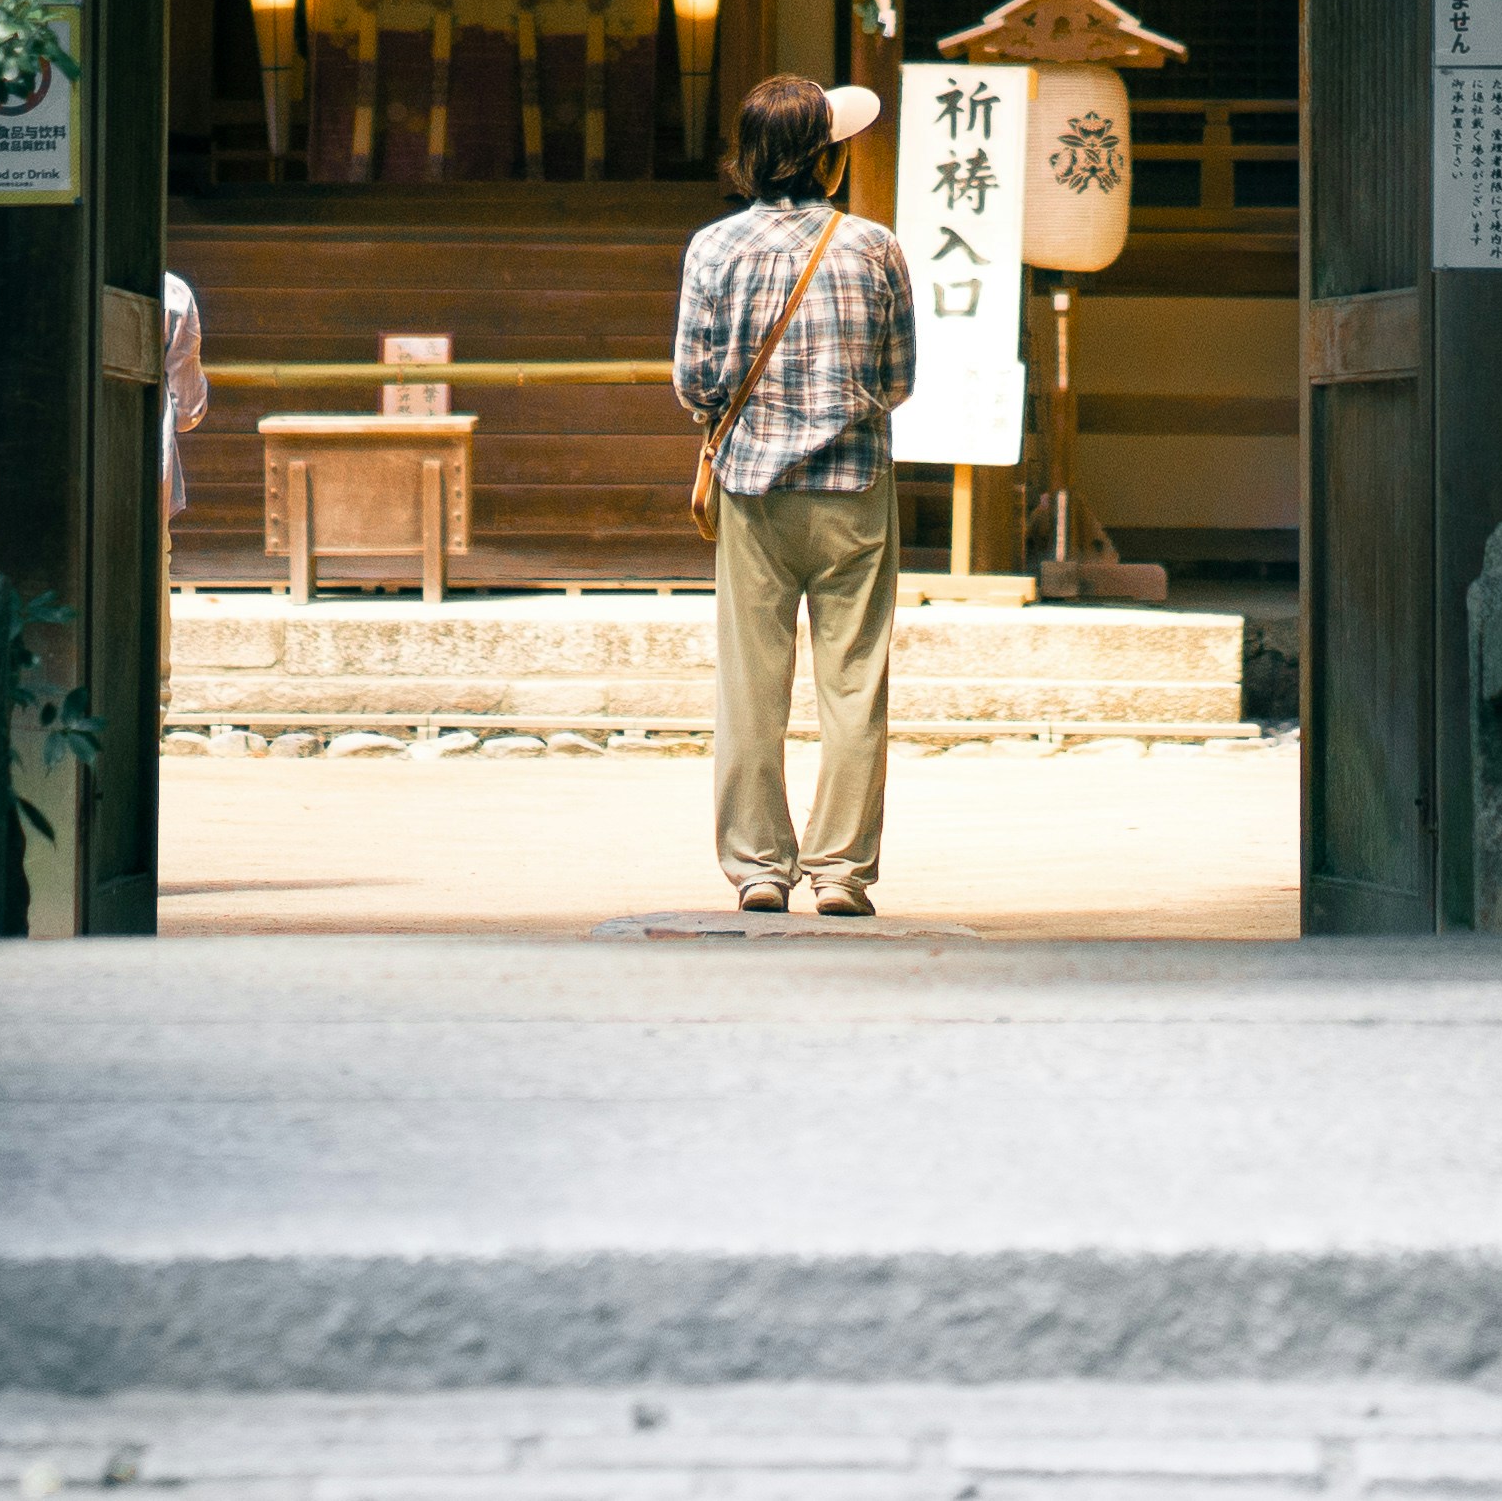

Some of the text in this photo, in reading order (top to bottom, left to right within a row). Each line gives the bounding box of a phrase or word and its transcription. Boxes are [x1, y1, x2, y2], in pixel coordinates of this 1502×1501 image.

[11, 171, 26, 179] or
[27, 168, 60, 179] Drink
[1451, 78, 1465, 180] 御承知置き下さい
[931, 78, 1001, 318] 祈祷入口
